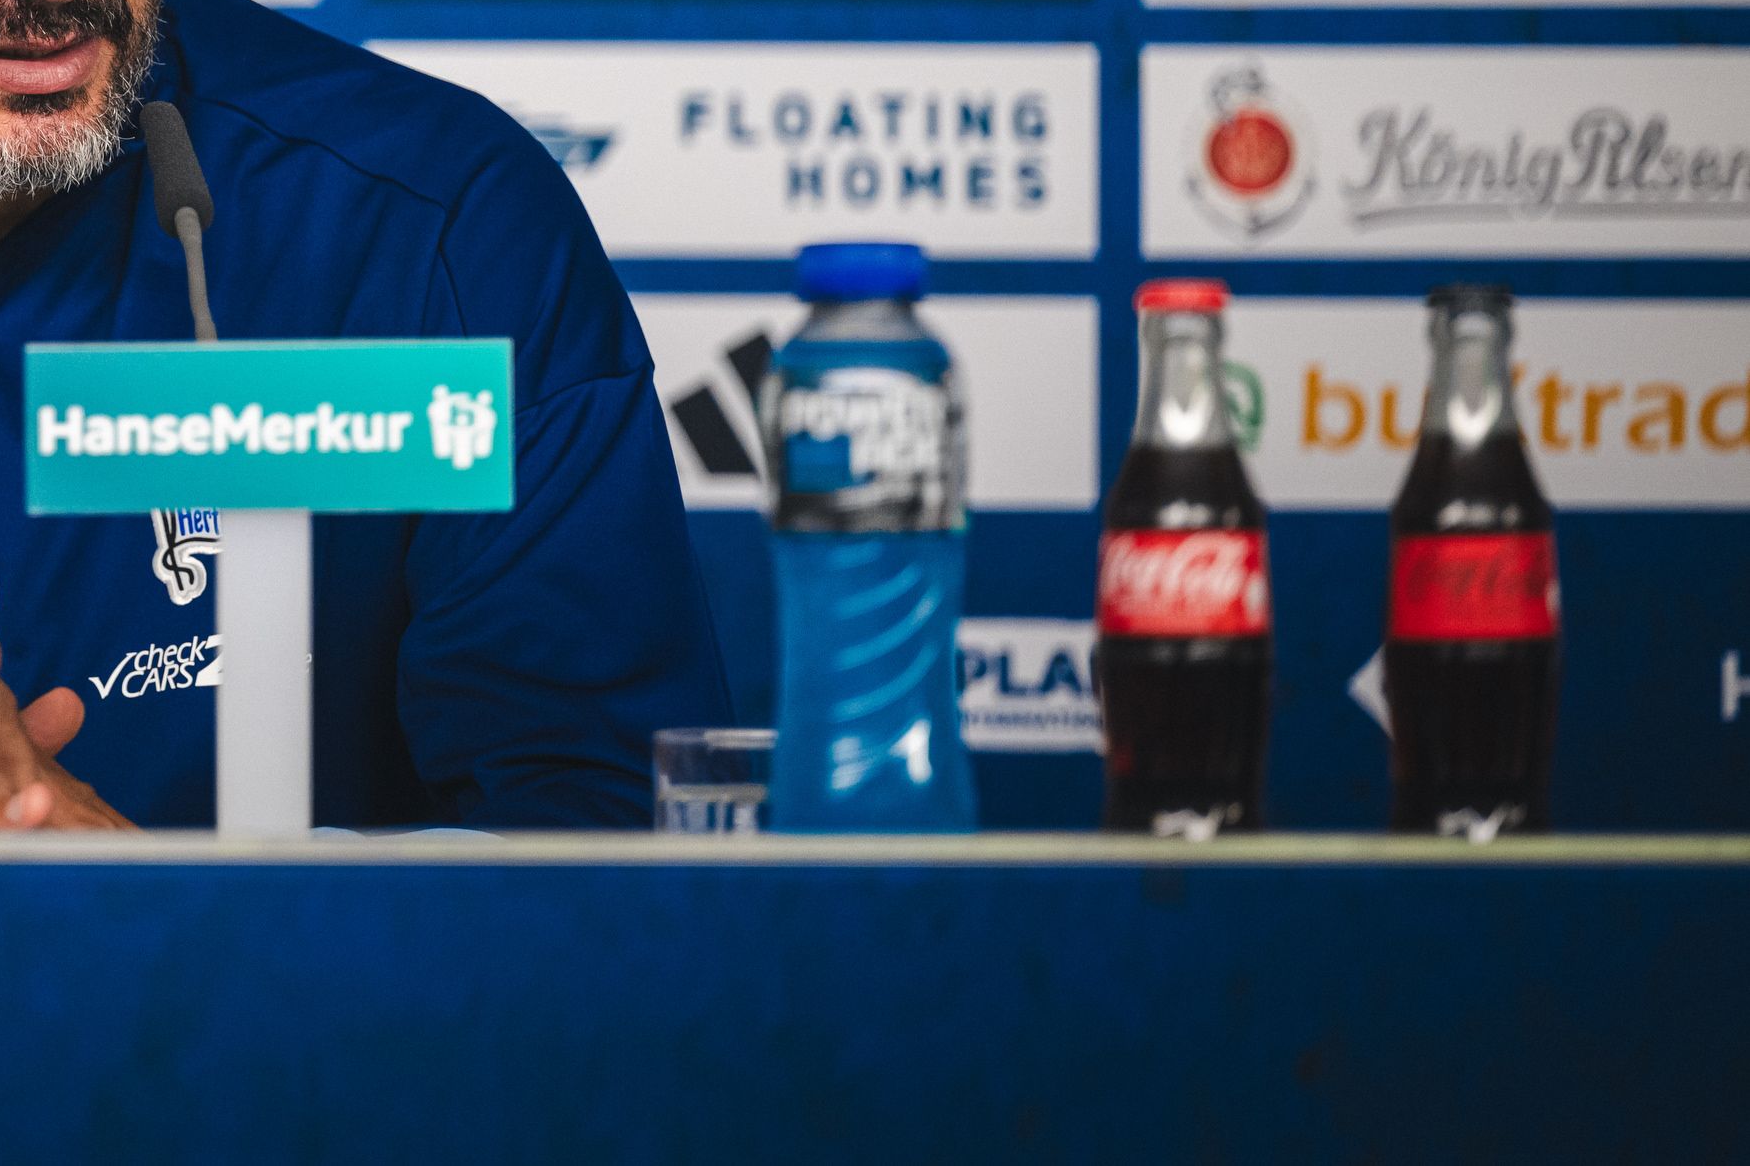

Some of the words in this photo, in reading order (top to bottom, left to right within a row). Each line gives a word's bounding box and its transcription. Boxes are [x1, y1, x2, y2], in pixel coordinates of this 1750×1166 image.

[678, 91, 1051, 145] FLOATING
[784, 156, 1049, 209] HOMES
[36, 402, 414, 456] HanseMerkur
[133, 635, 207, 673] check
[954, 649, 1084, 697] PLA
[121, 661, 195, 699] CARS
